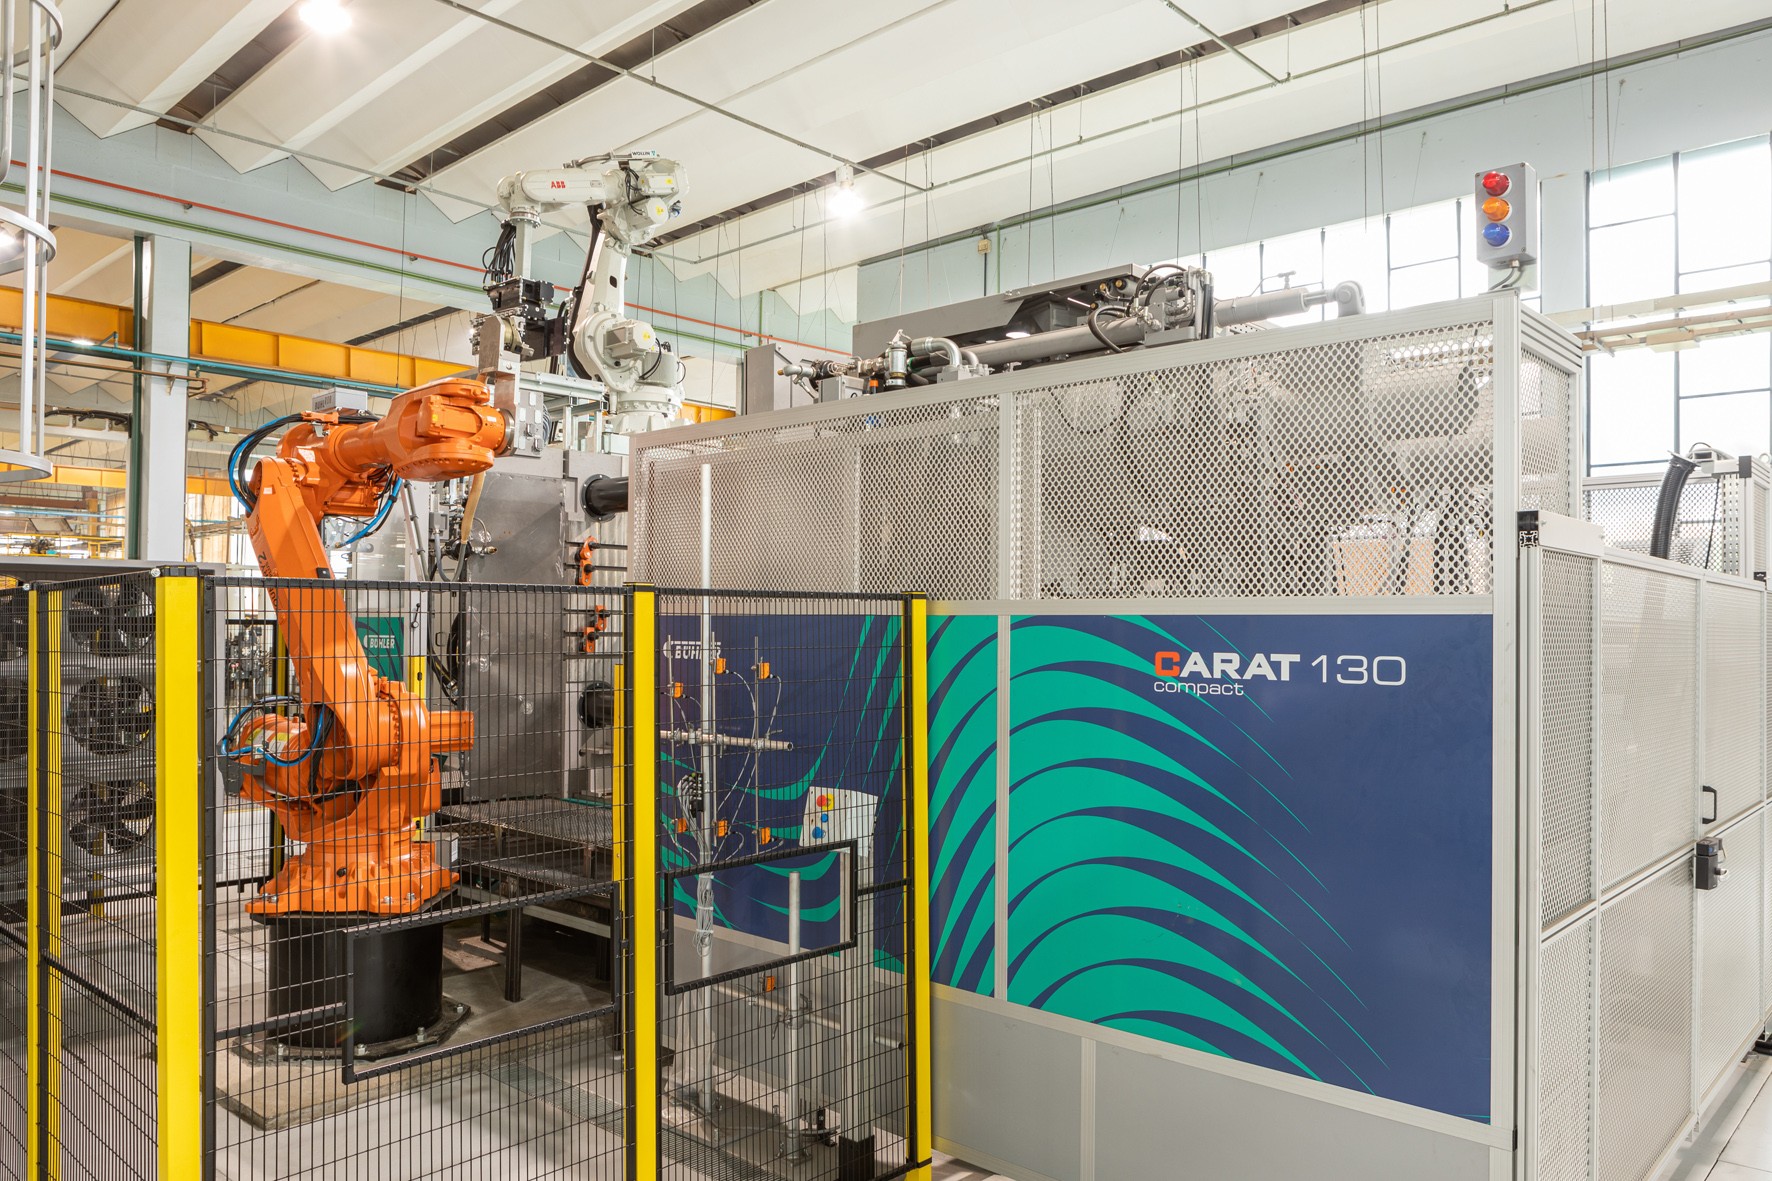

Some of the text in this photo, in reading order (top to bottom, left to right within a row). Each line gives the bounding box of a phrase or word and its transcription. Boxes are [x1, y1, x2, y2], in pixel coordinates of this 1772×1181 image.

[551, 181, 566, 189] ABB
[1154, 651, 1407, 686] CARAT 130
[1153, 681, 1244, 696] compact
